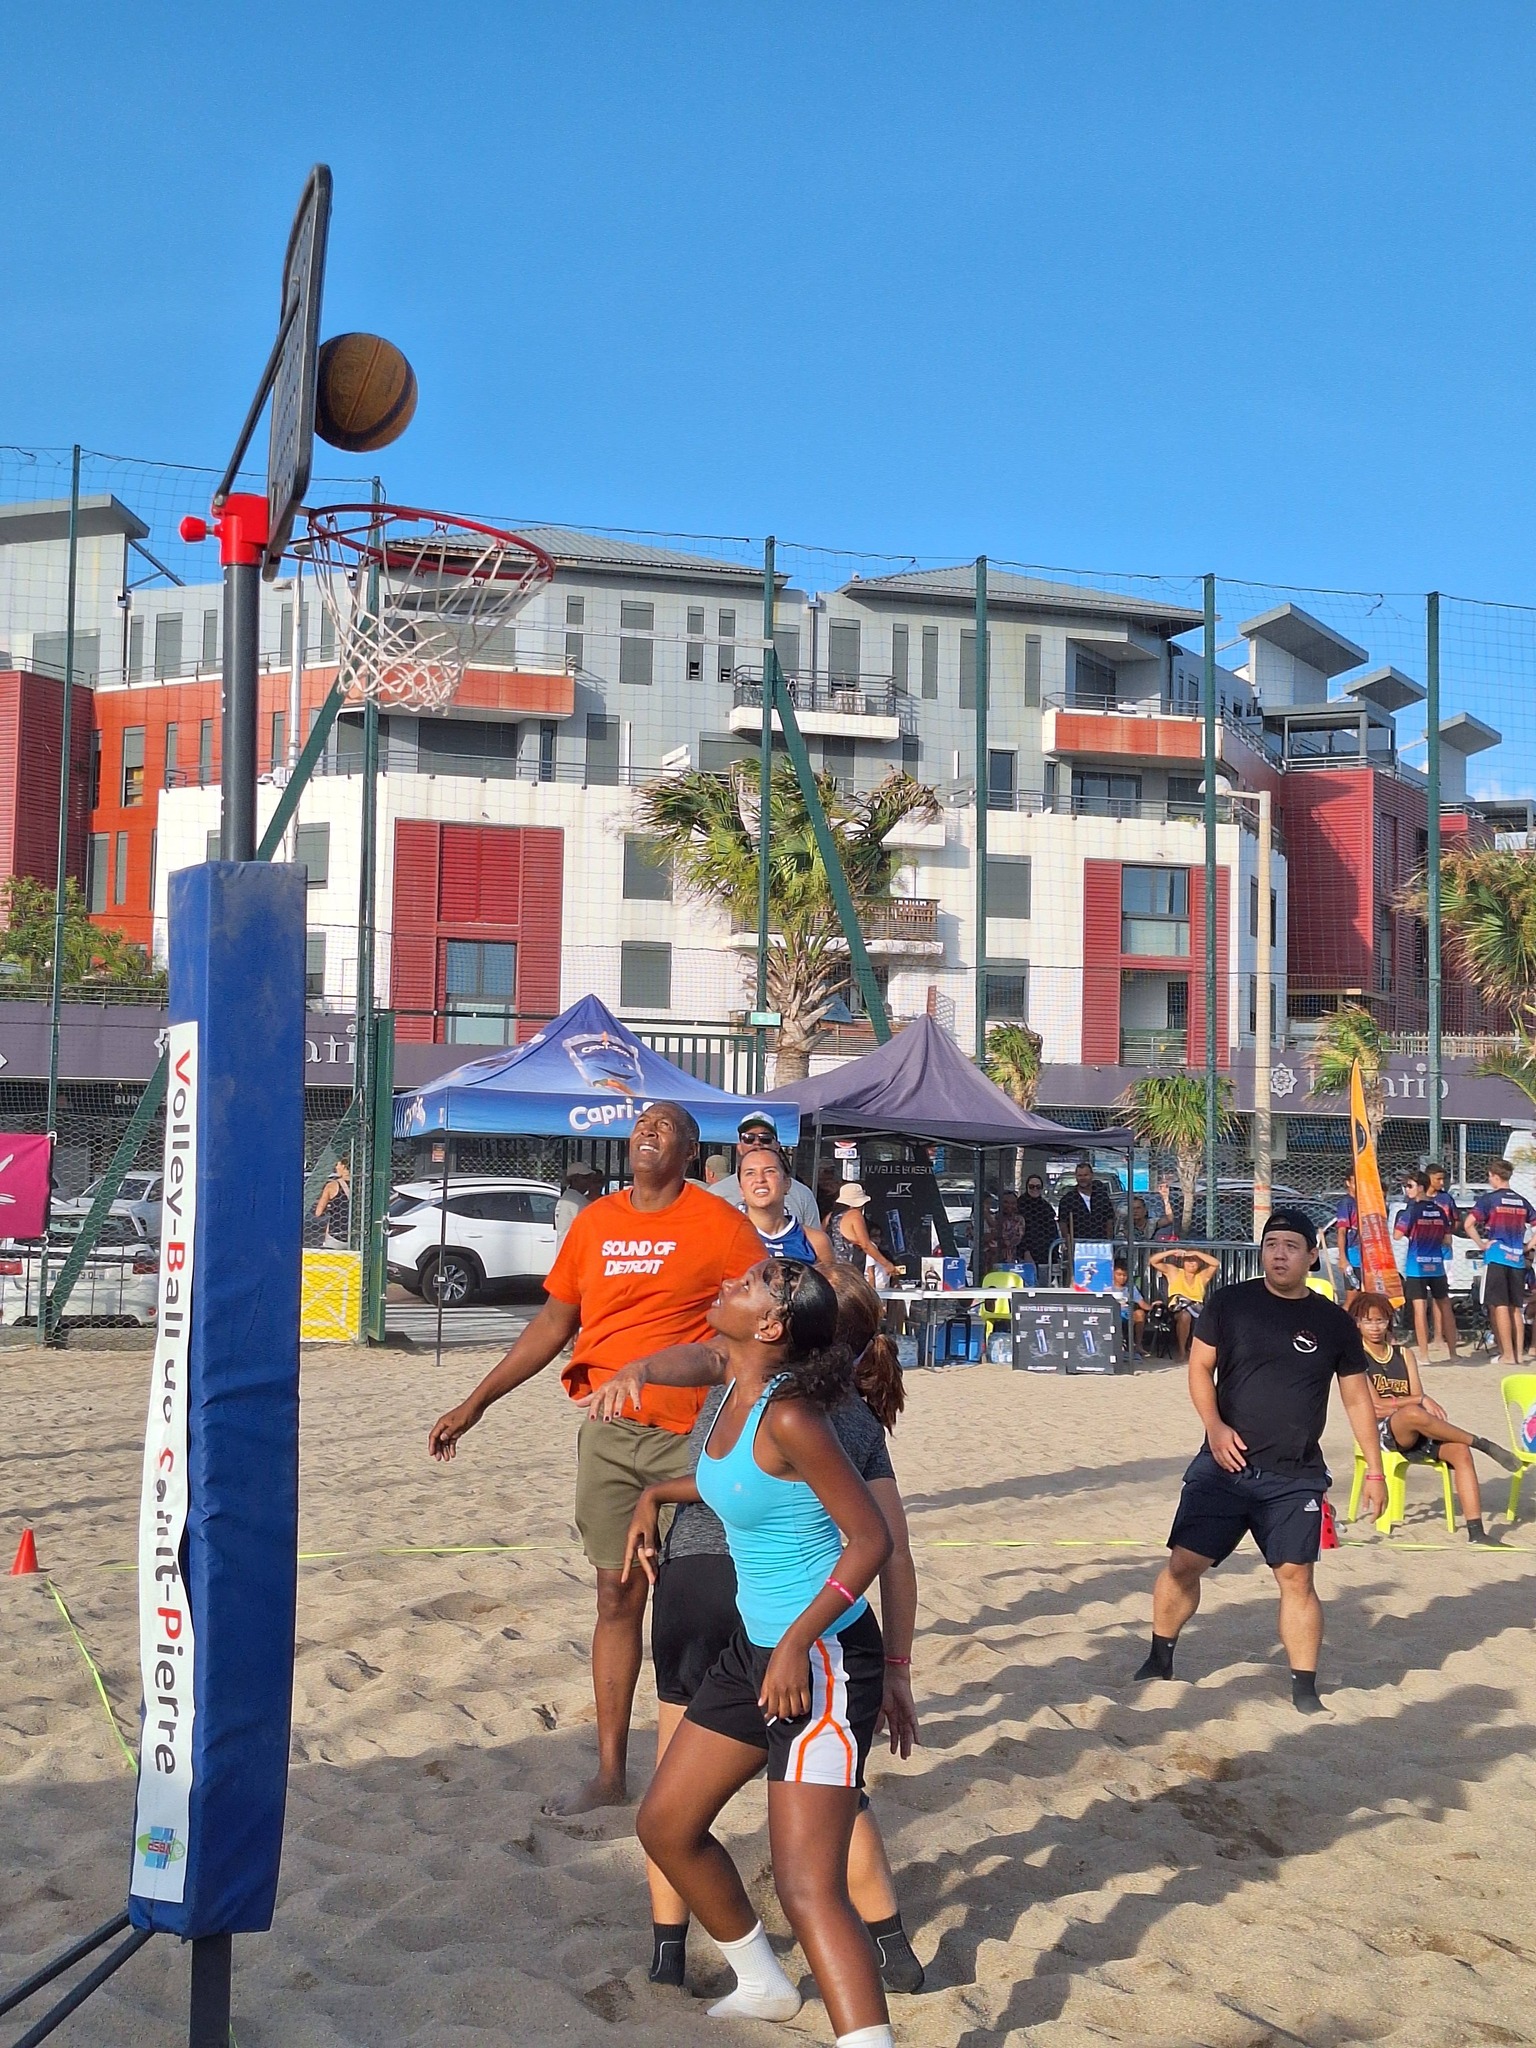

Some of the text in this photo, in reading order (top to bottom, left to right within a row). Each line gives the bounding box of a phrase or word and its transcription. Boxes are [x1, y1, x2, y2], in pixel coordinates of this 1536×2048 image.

[165, 1049, 191, 1338] Volley-Ball
[602, 1240, 677, 1257] SOUND OF
[604, 1259, 665, 1277] DETROIT
